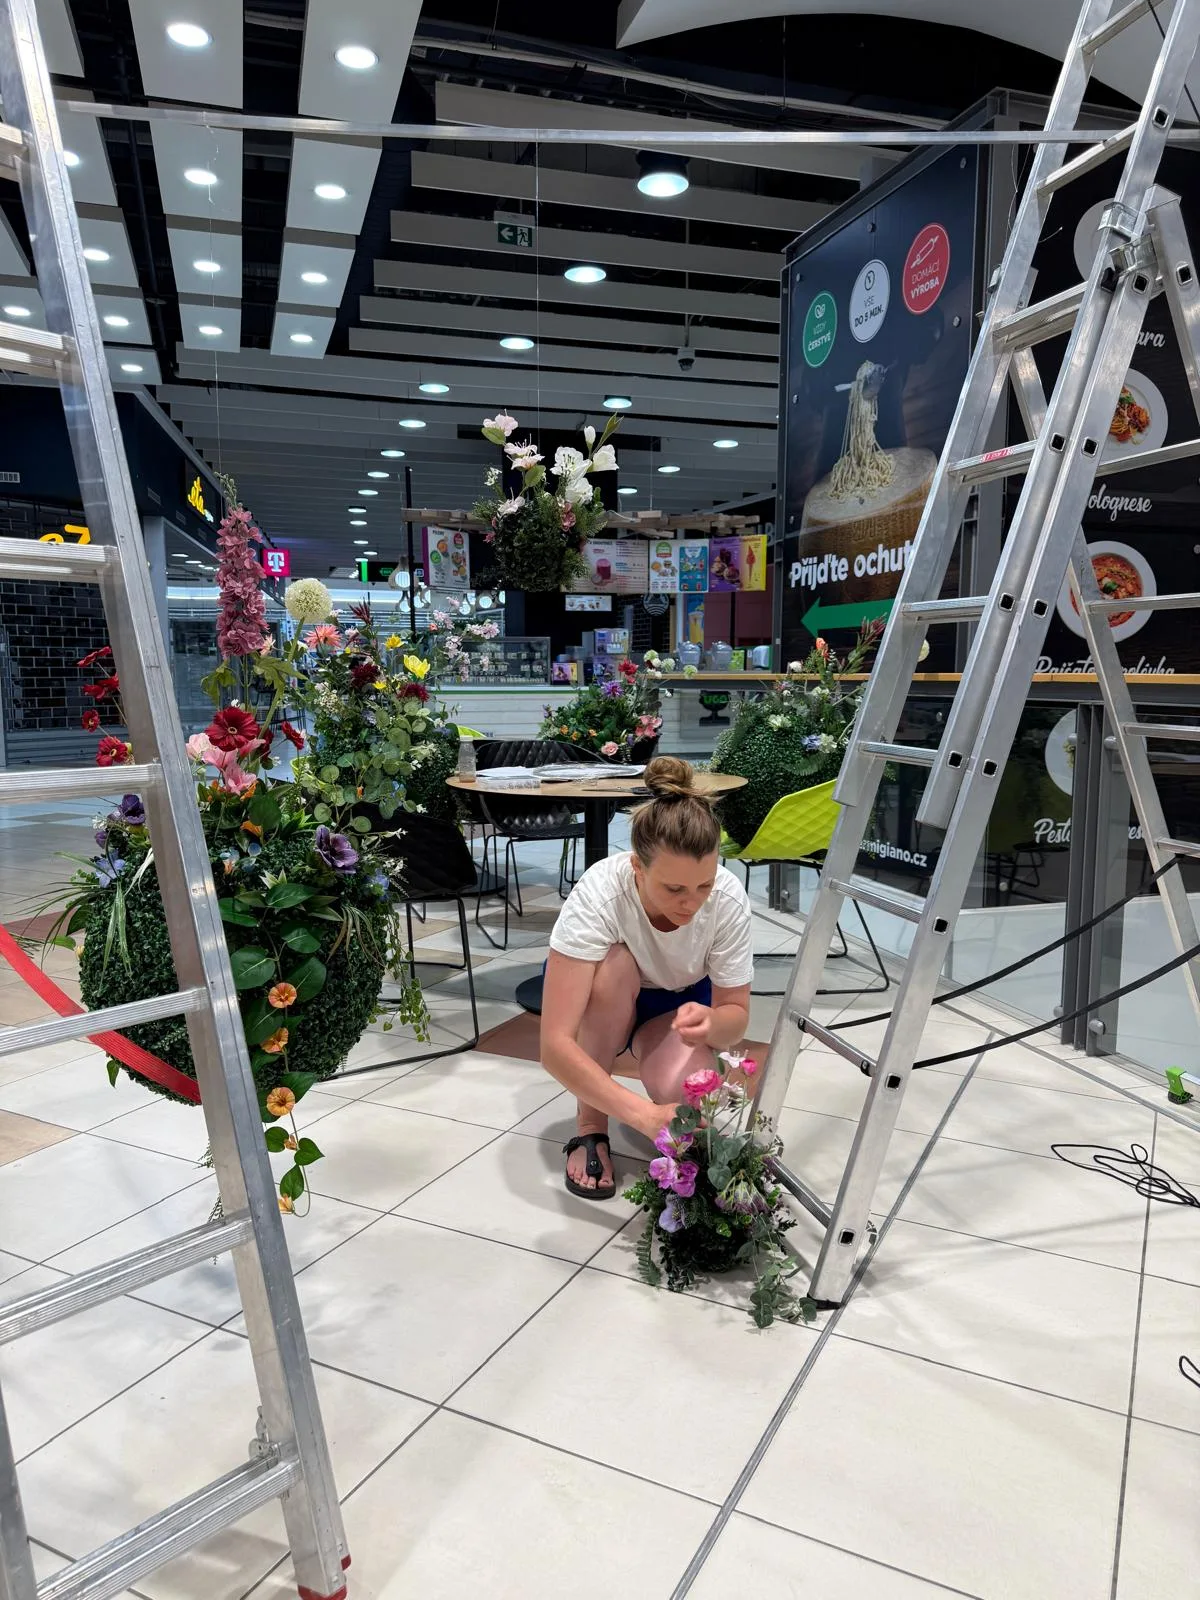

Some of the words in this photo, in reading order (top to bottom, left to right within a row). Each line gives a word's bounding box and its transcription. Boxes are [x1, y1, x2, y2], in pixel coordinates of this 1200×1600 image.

[911, 277, 940, 299] VÝROBA
[854, 314, 864, 328] DO
[1088, 483, 1153, 522] olognese
[267, 551, 285, 573] T
[790, 553, 849, 591] Přijďte
[853, 540, 914, 578] ochut
